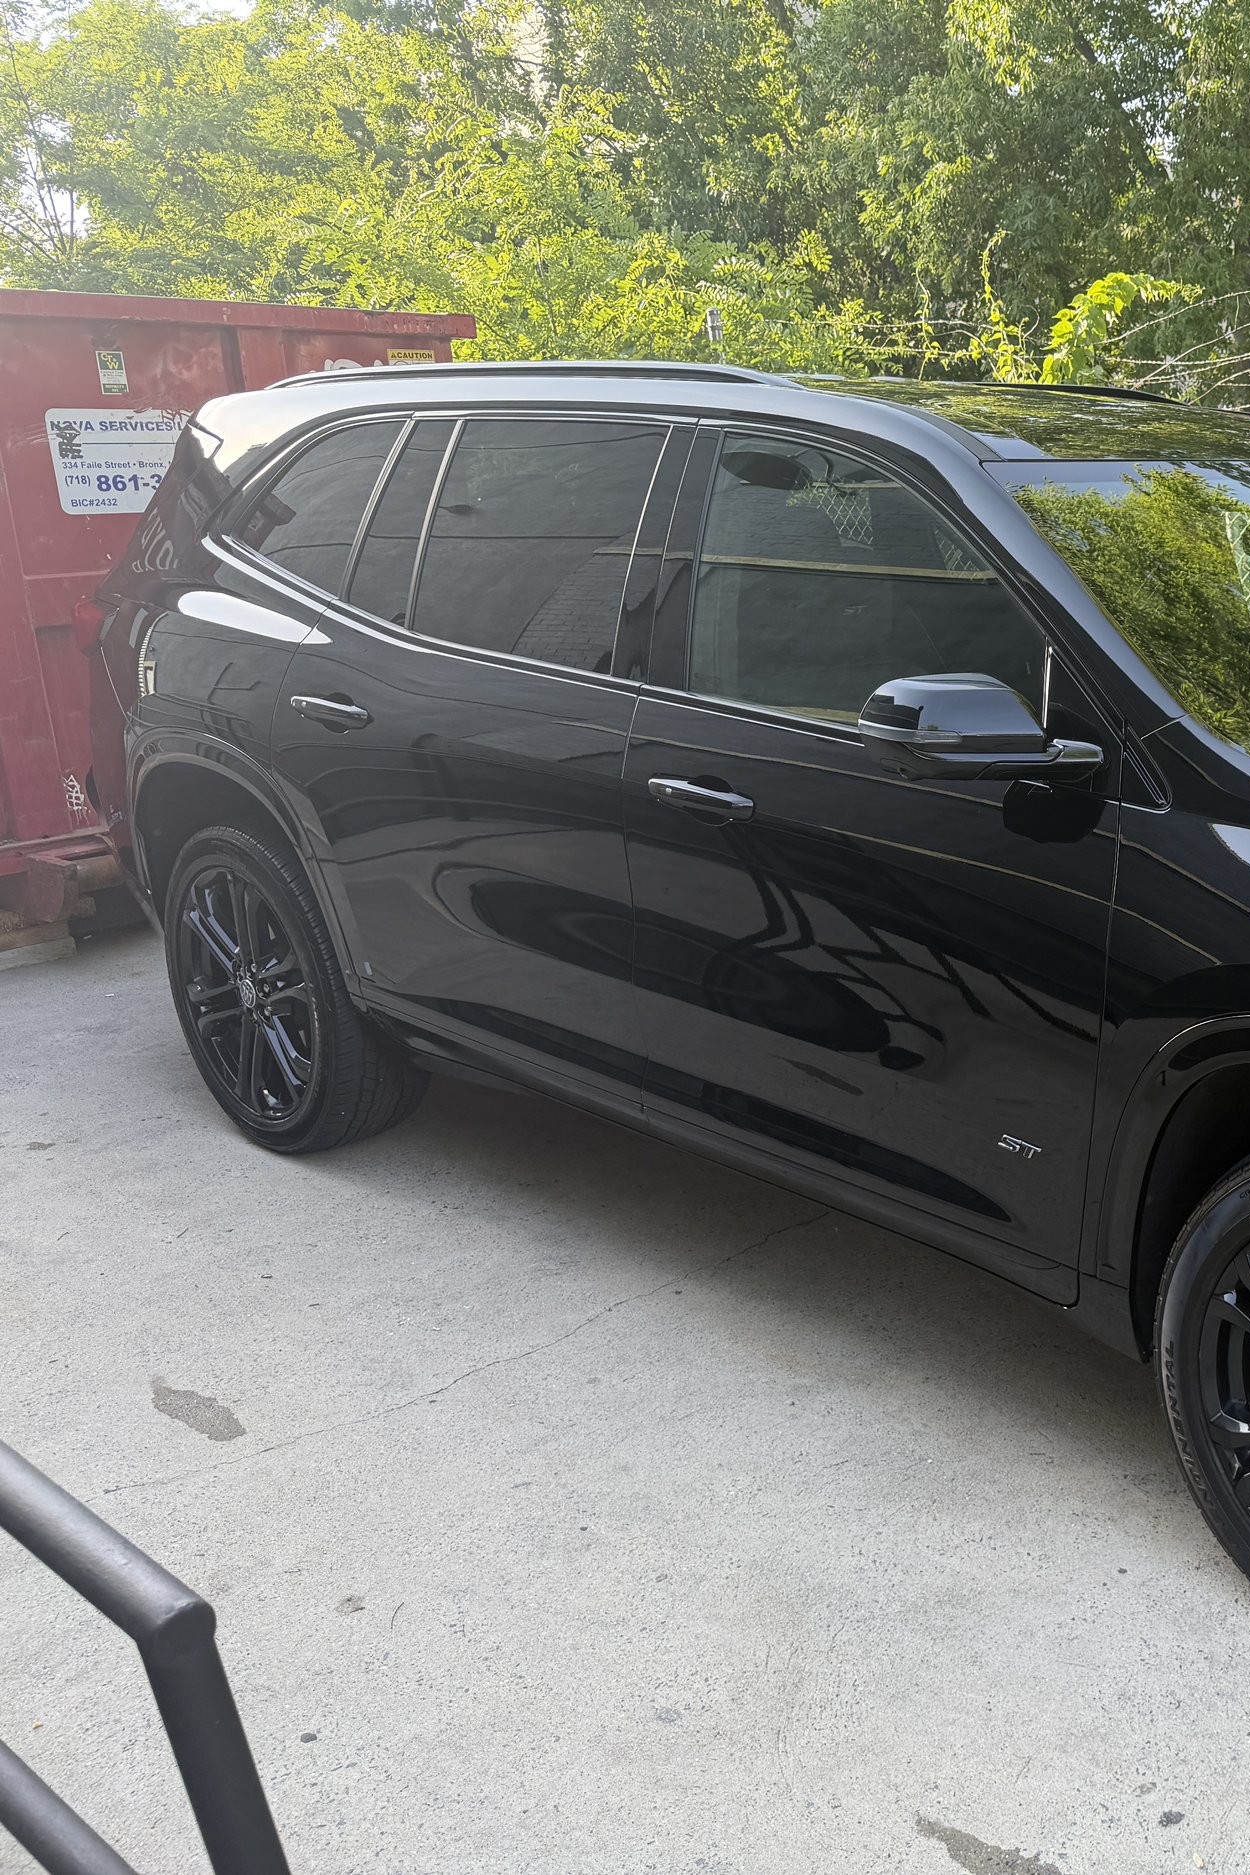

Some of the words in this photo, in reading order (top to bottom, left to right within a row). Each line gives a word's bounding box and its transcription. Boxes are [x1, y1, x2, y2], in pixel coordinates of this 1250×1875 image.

[99, 420, 173, 432] SERVICES
[62, 461, 78, 469] 334
[81, 461, 103, 469] Faile
[104, 461, 131, 469] Street
[138, 461, 167, 470] Bronx,
[64, 475, 91, 487] (718)
[71, 499, 118, 507] BIC#2432
[998, 1134, 1042, 1159] ST
